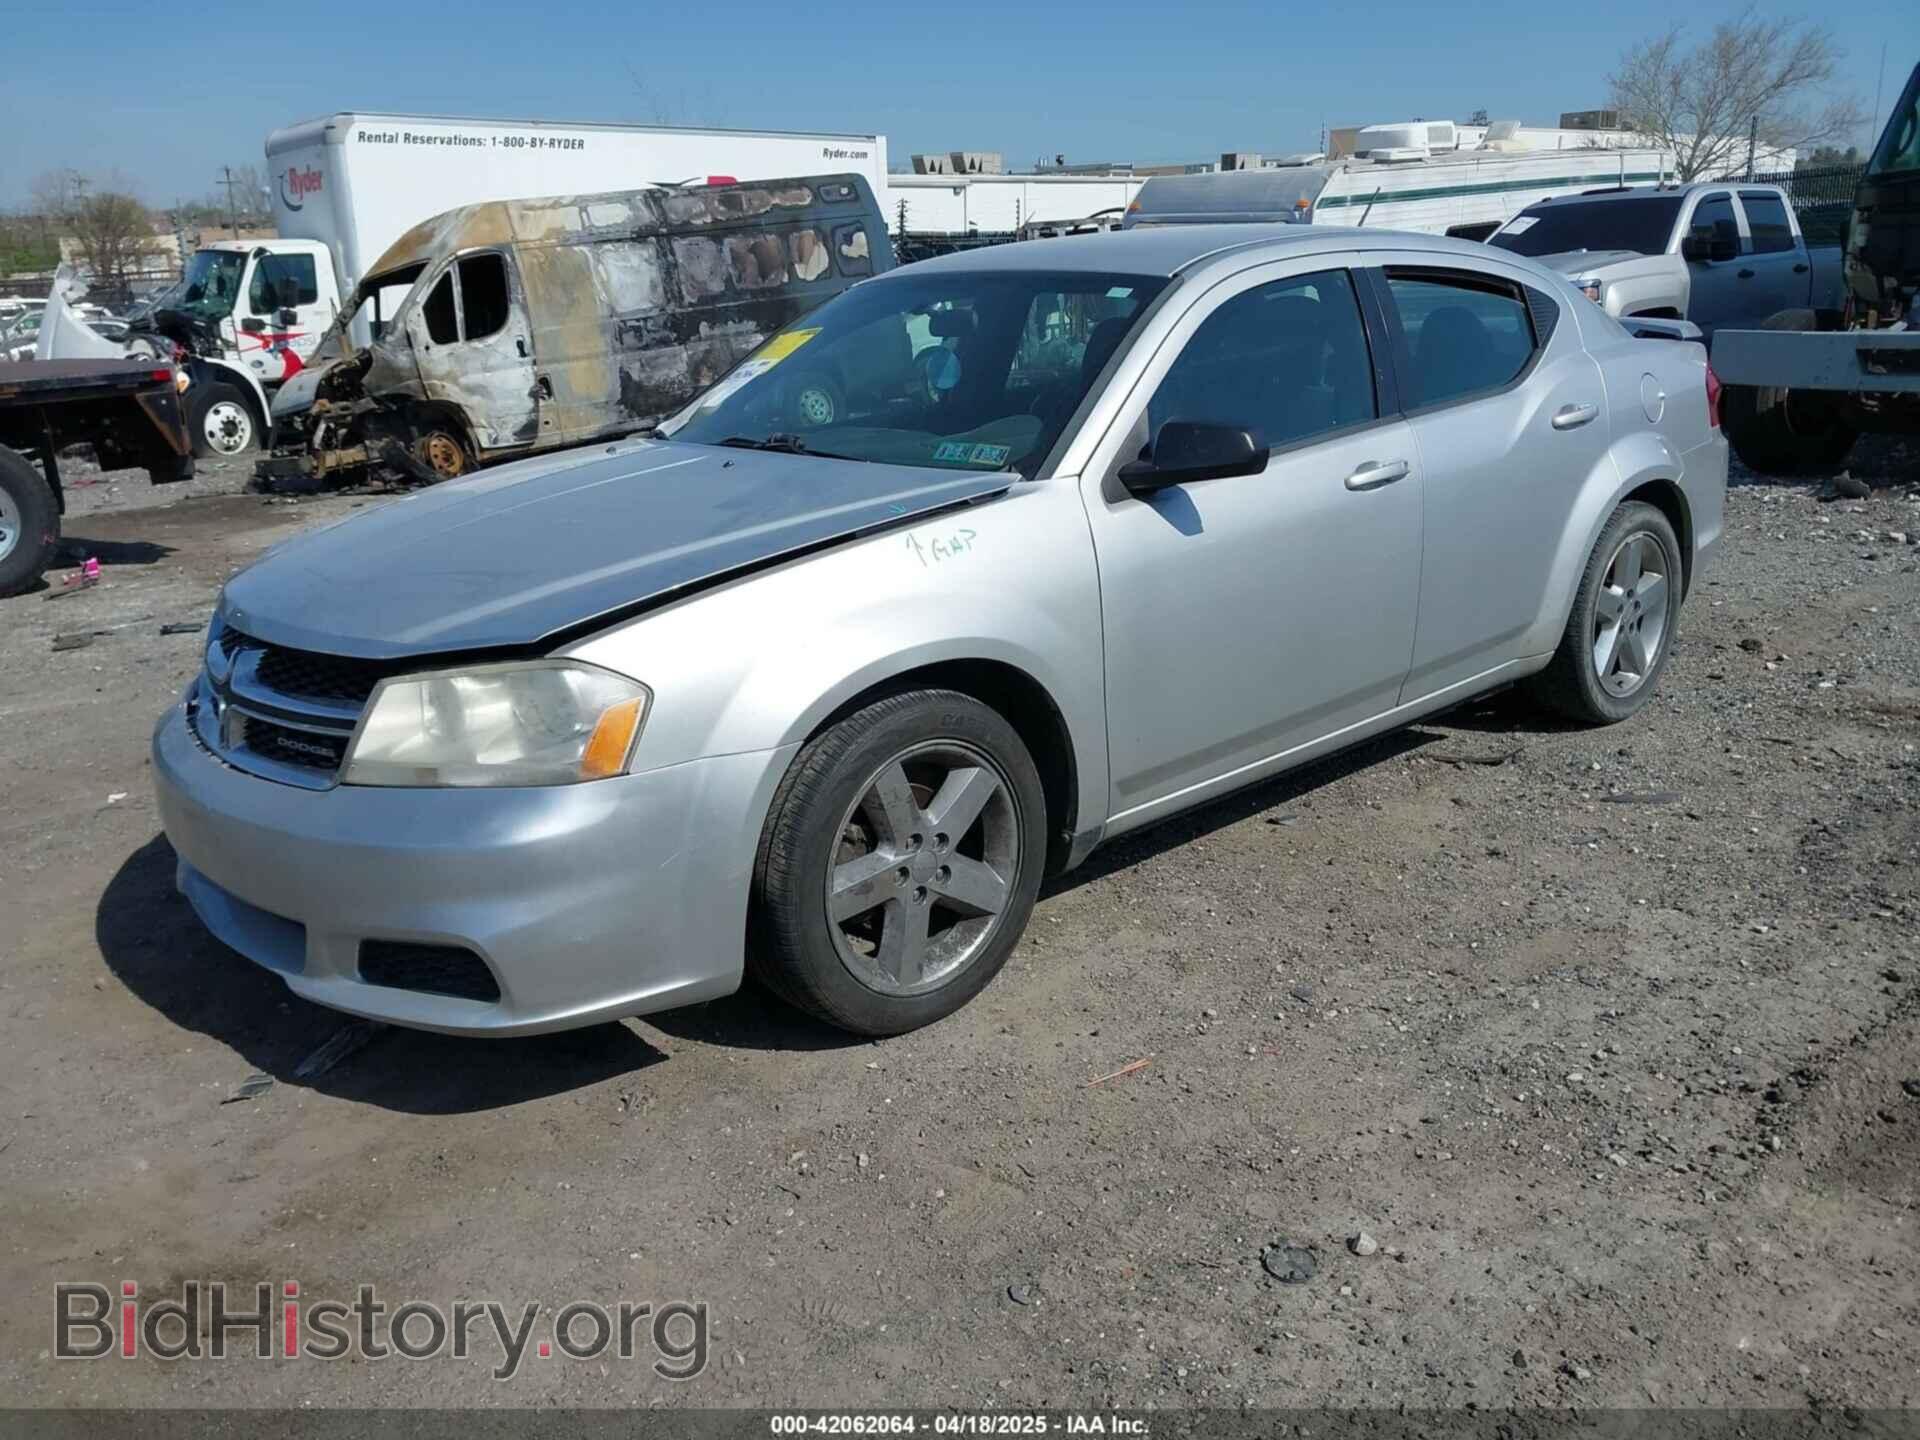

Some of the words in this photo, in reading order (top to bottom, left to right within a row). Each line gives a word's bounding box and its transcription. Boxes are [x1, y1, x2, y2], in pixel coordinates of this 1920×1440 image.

[357, 131, 399, 144] Rental
[403, 132, 487, 147] Reservations:
[491, 136, 585, 150] 1-800-BY-RYDER
[823, 148, 868, 160] Ryder.com
[288, 165, 323, 200] Ryder
[277, 737, 335, 757] DODGE
